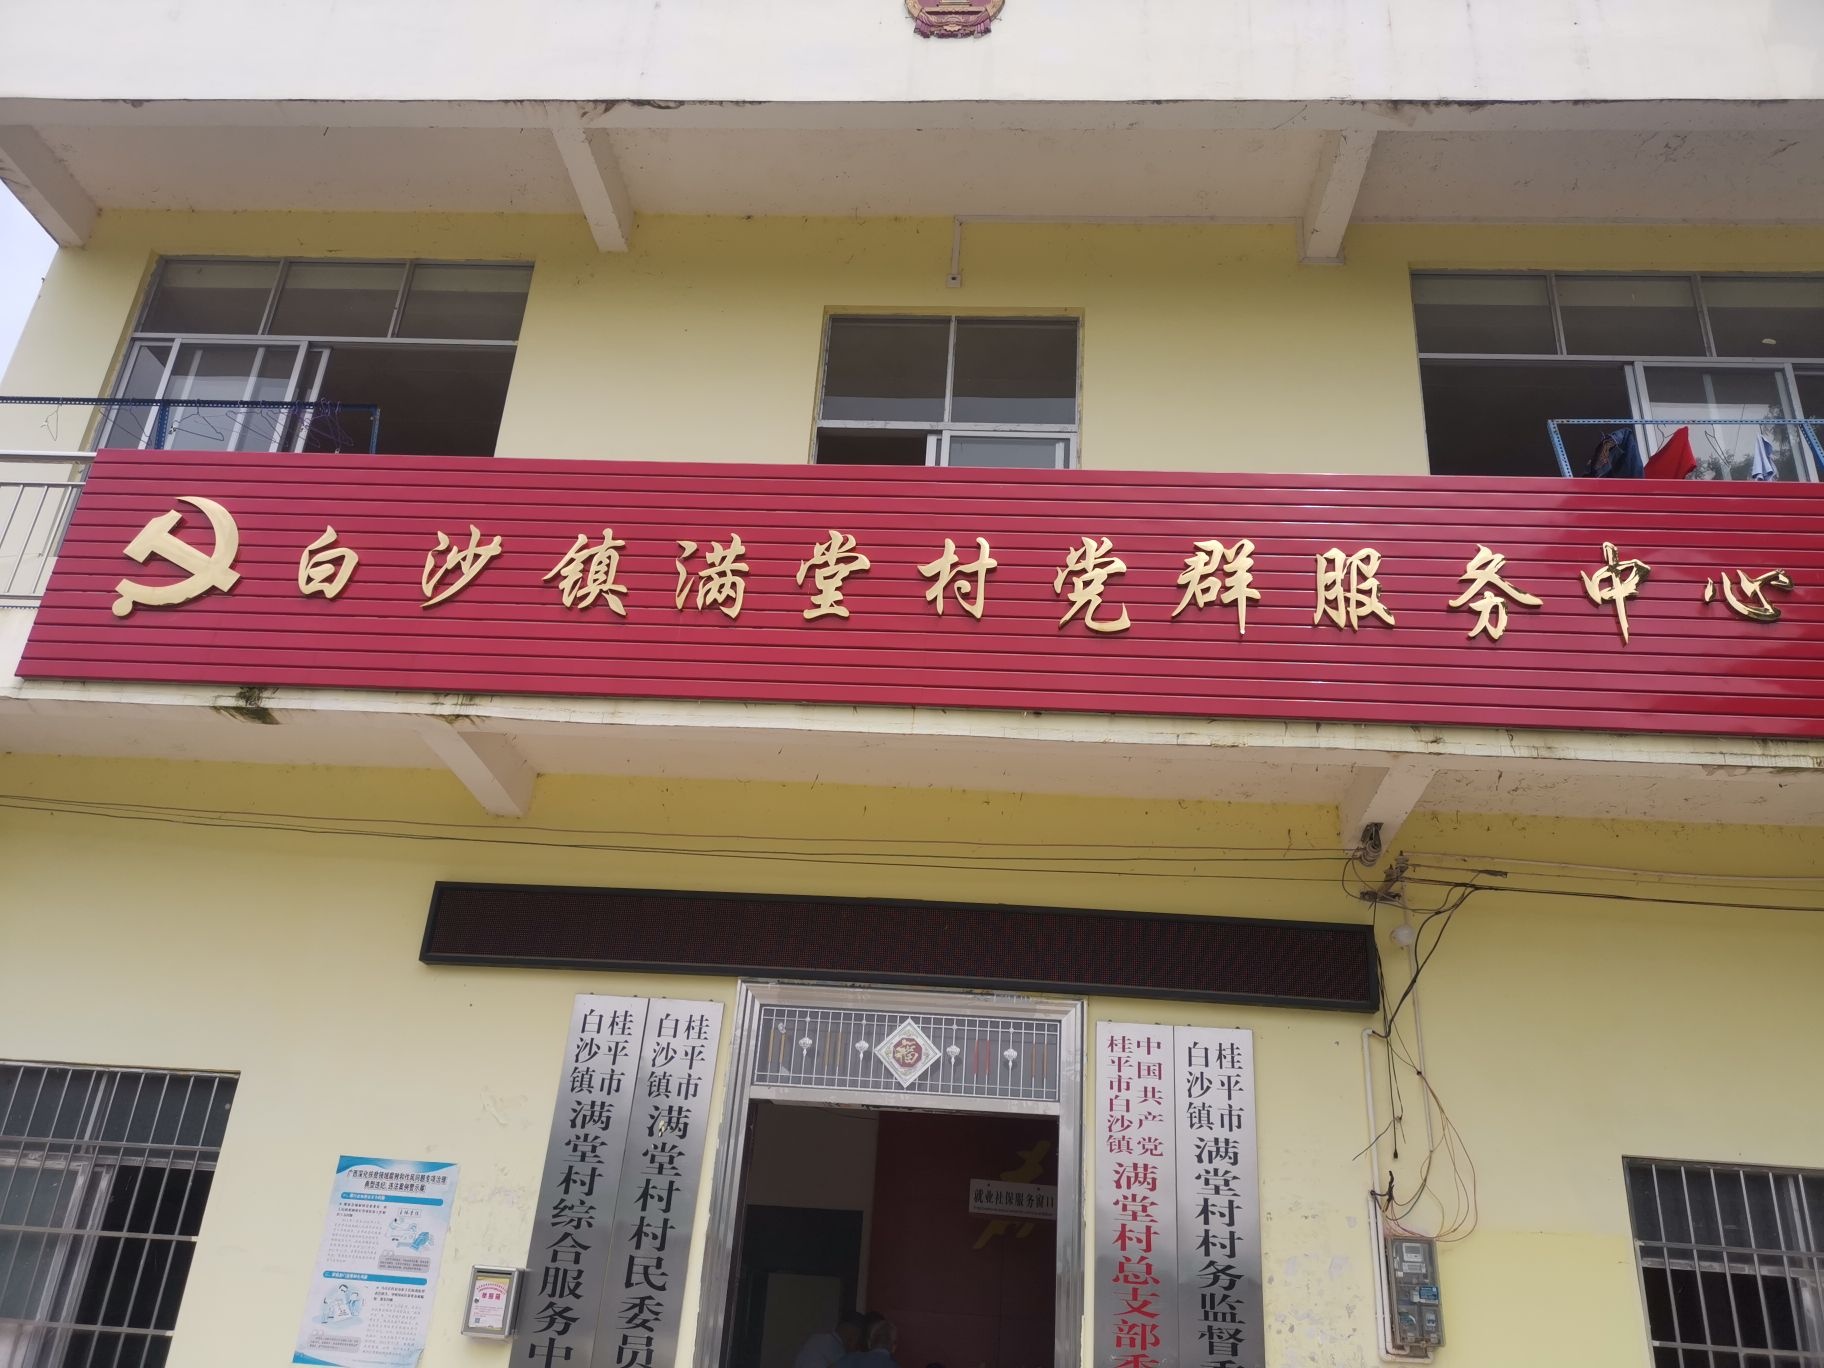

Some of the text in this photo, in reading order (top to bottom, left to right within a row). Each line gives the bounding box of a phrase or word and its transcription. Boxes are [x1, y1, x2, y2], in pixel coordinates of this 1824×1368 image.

[297, 523, 1795, 645] 白沙镇满堂村党群服务中心
[570, 1008, 604, 1095] 白沙镇
[598, 1009, 634, 1096] 桂平市
[647, 1012, 680, 1099] 白沙镇
[675, 1014, 710, 1101] 桂平市
[1107, 1035, 1133, 1155] 桂平市白沙镇
[1136, 1036, 1164, 1157] 中国共产党
[1186, 1041, 1215, 1131] 白沙镇
[1215, 1042, 1243, 1133] 桂平市
[528, 1100, 615, 1368] 满堂村综合服务中
[616, 1105, 692, 1368] 满堂村村民委员
[1194, 1136, 1246, 1368] 满堂村村务监督
